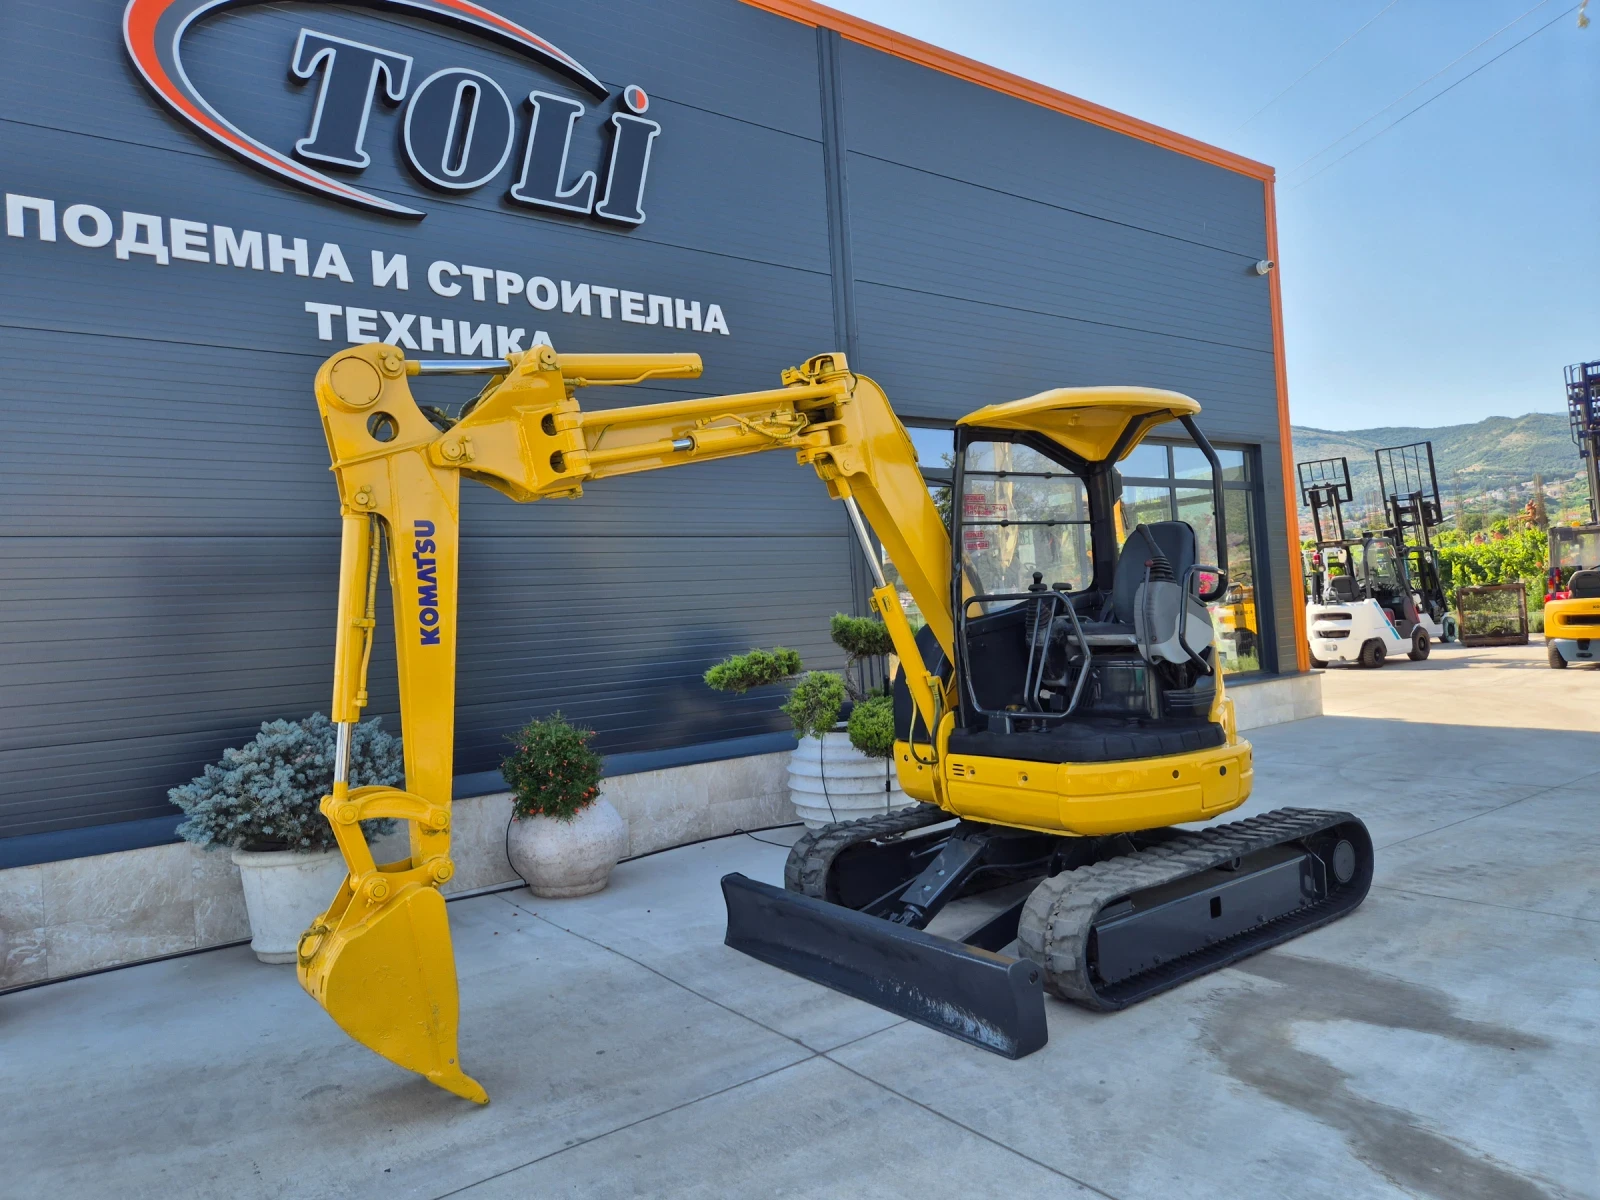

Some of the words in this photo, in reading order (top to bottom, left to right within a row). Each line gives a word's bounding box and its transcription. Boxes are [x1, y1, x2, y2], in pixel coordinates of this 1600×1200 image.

[6, 193, 354, 283] ПОДЕМНА
[371, 250, 409, 290] И
[427, 260, 730, 335] СТРОИТЕЛНА
[412, 519, 441, 646] KOMATSU
